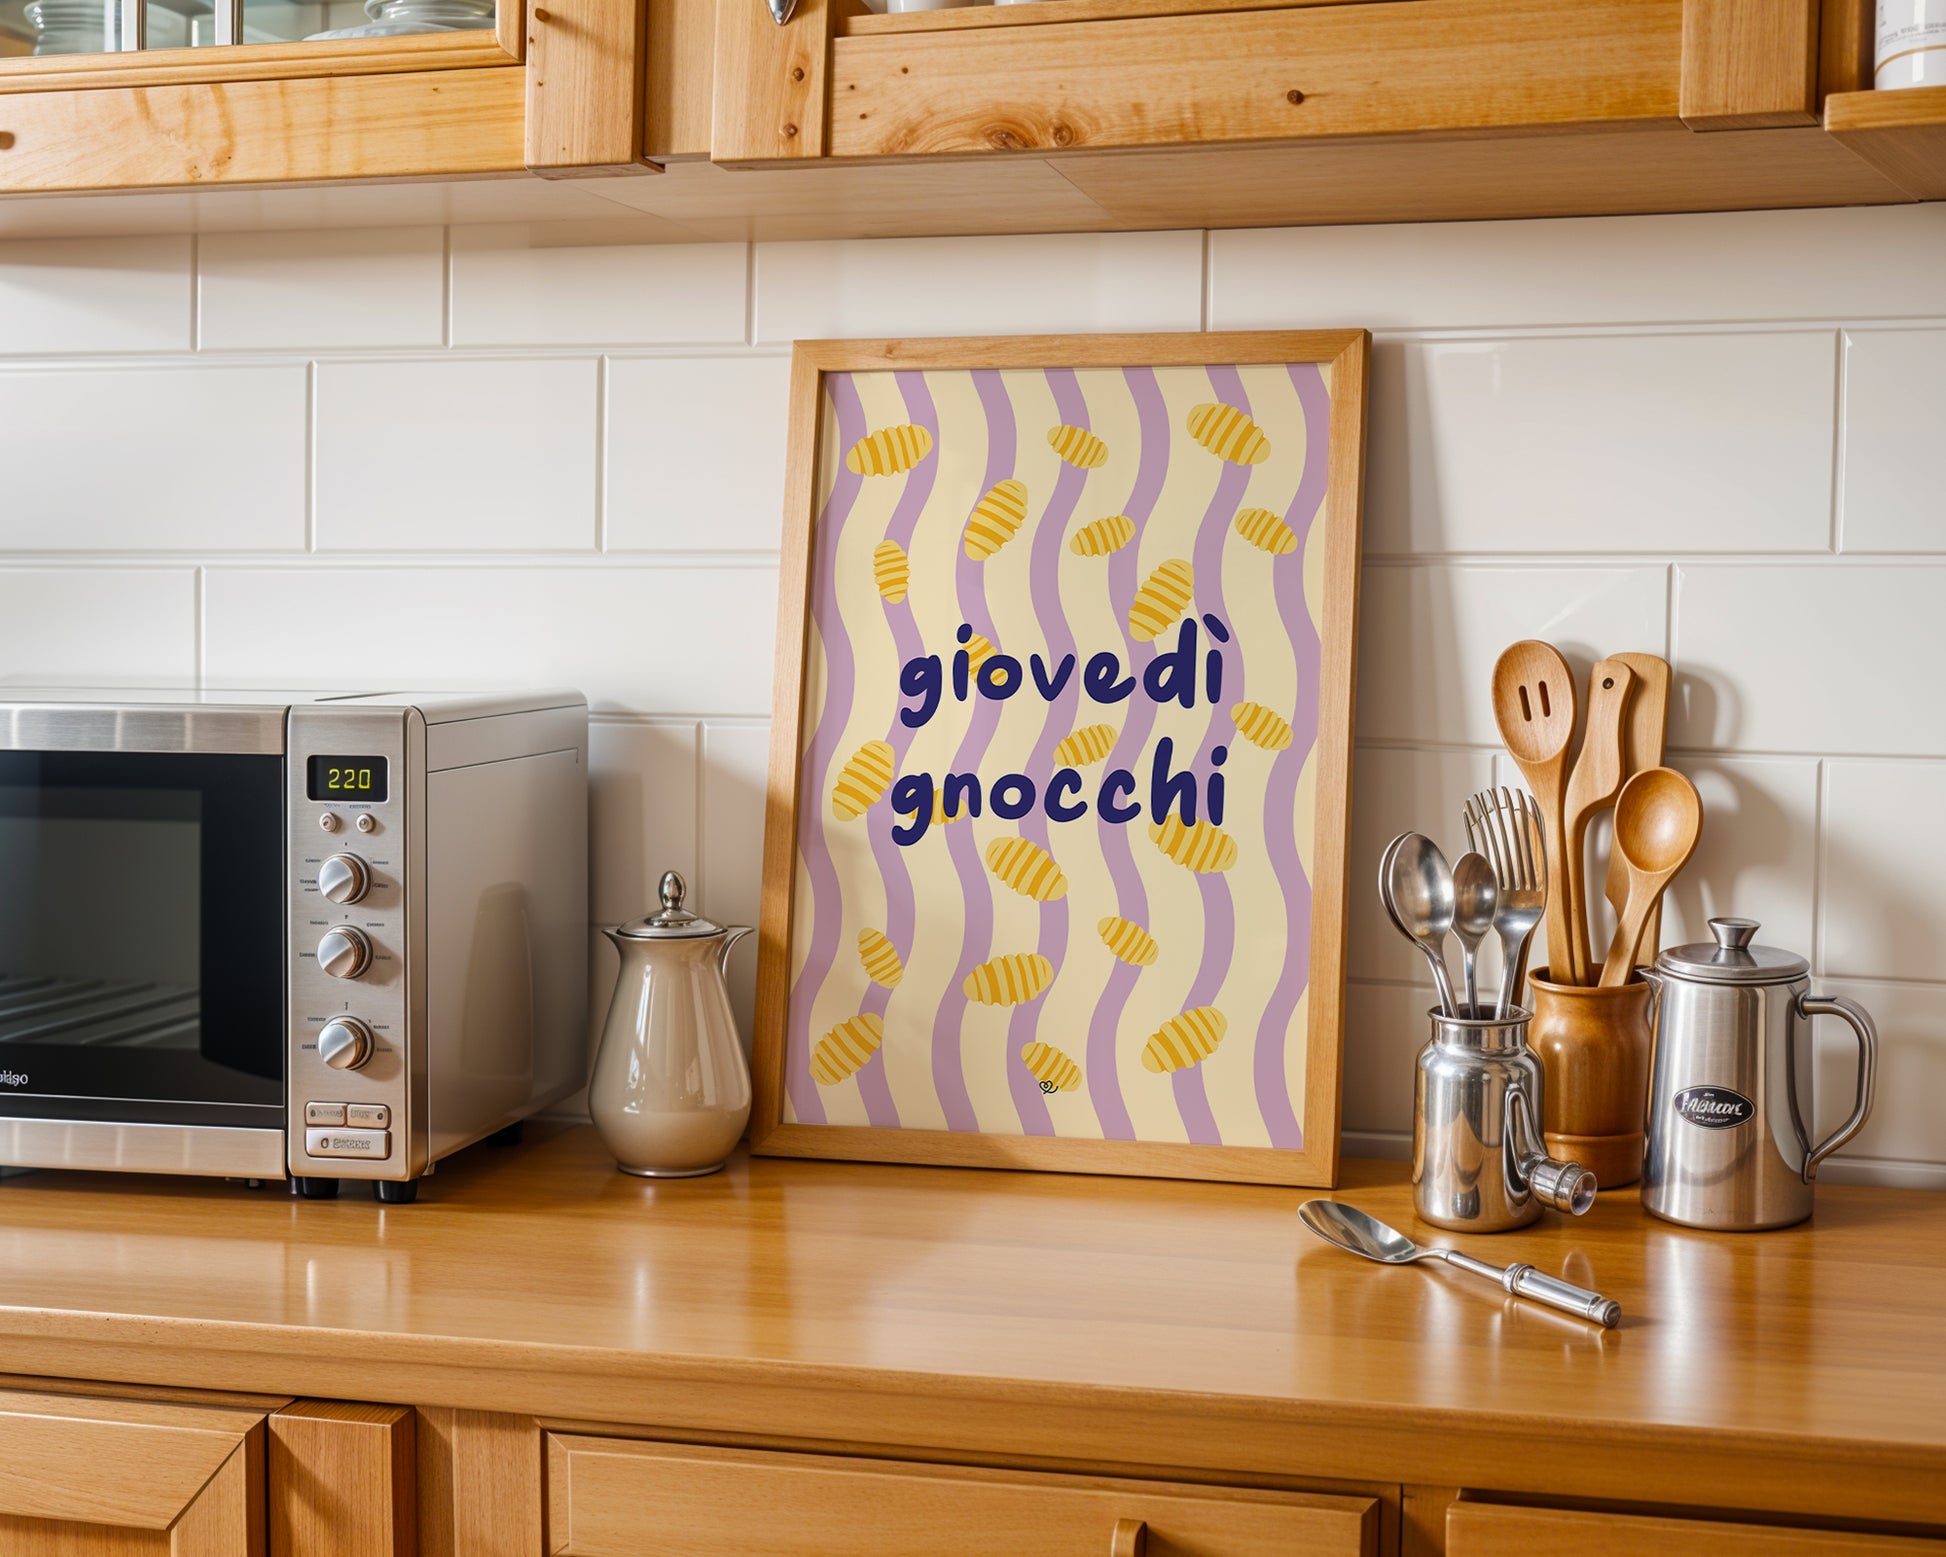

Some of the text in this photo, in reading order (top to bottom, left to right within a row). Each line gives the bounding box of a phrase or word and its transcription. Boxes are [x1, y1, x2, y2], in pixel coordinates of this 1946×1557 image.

[899, 613, 1230, 729] giovedì
[328, 768, 371, 789] 220
[890, 736, 1228, 847] gnocchi
